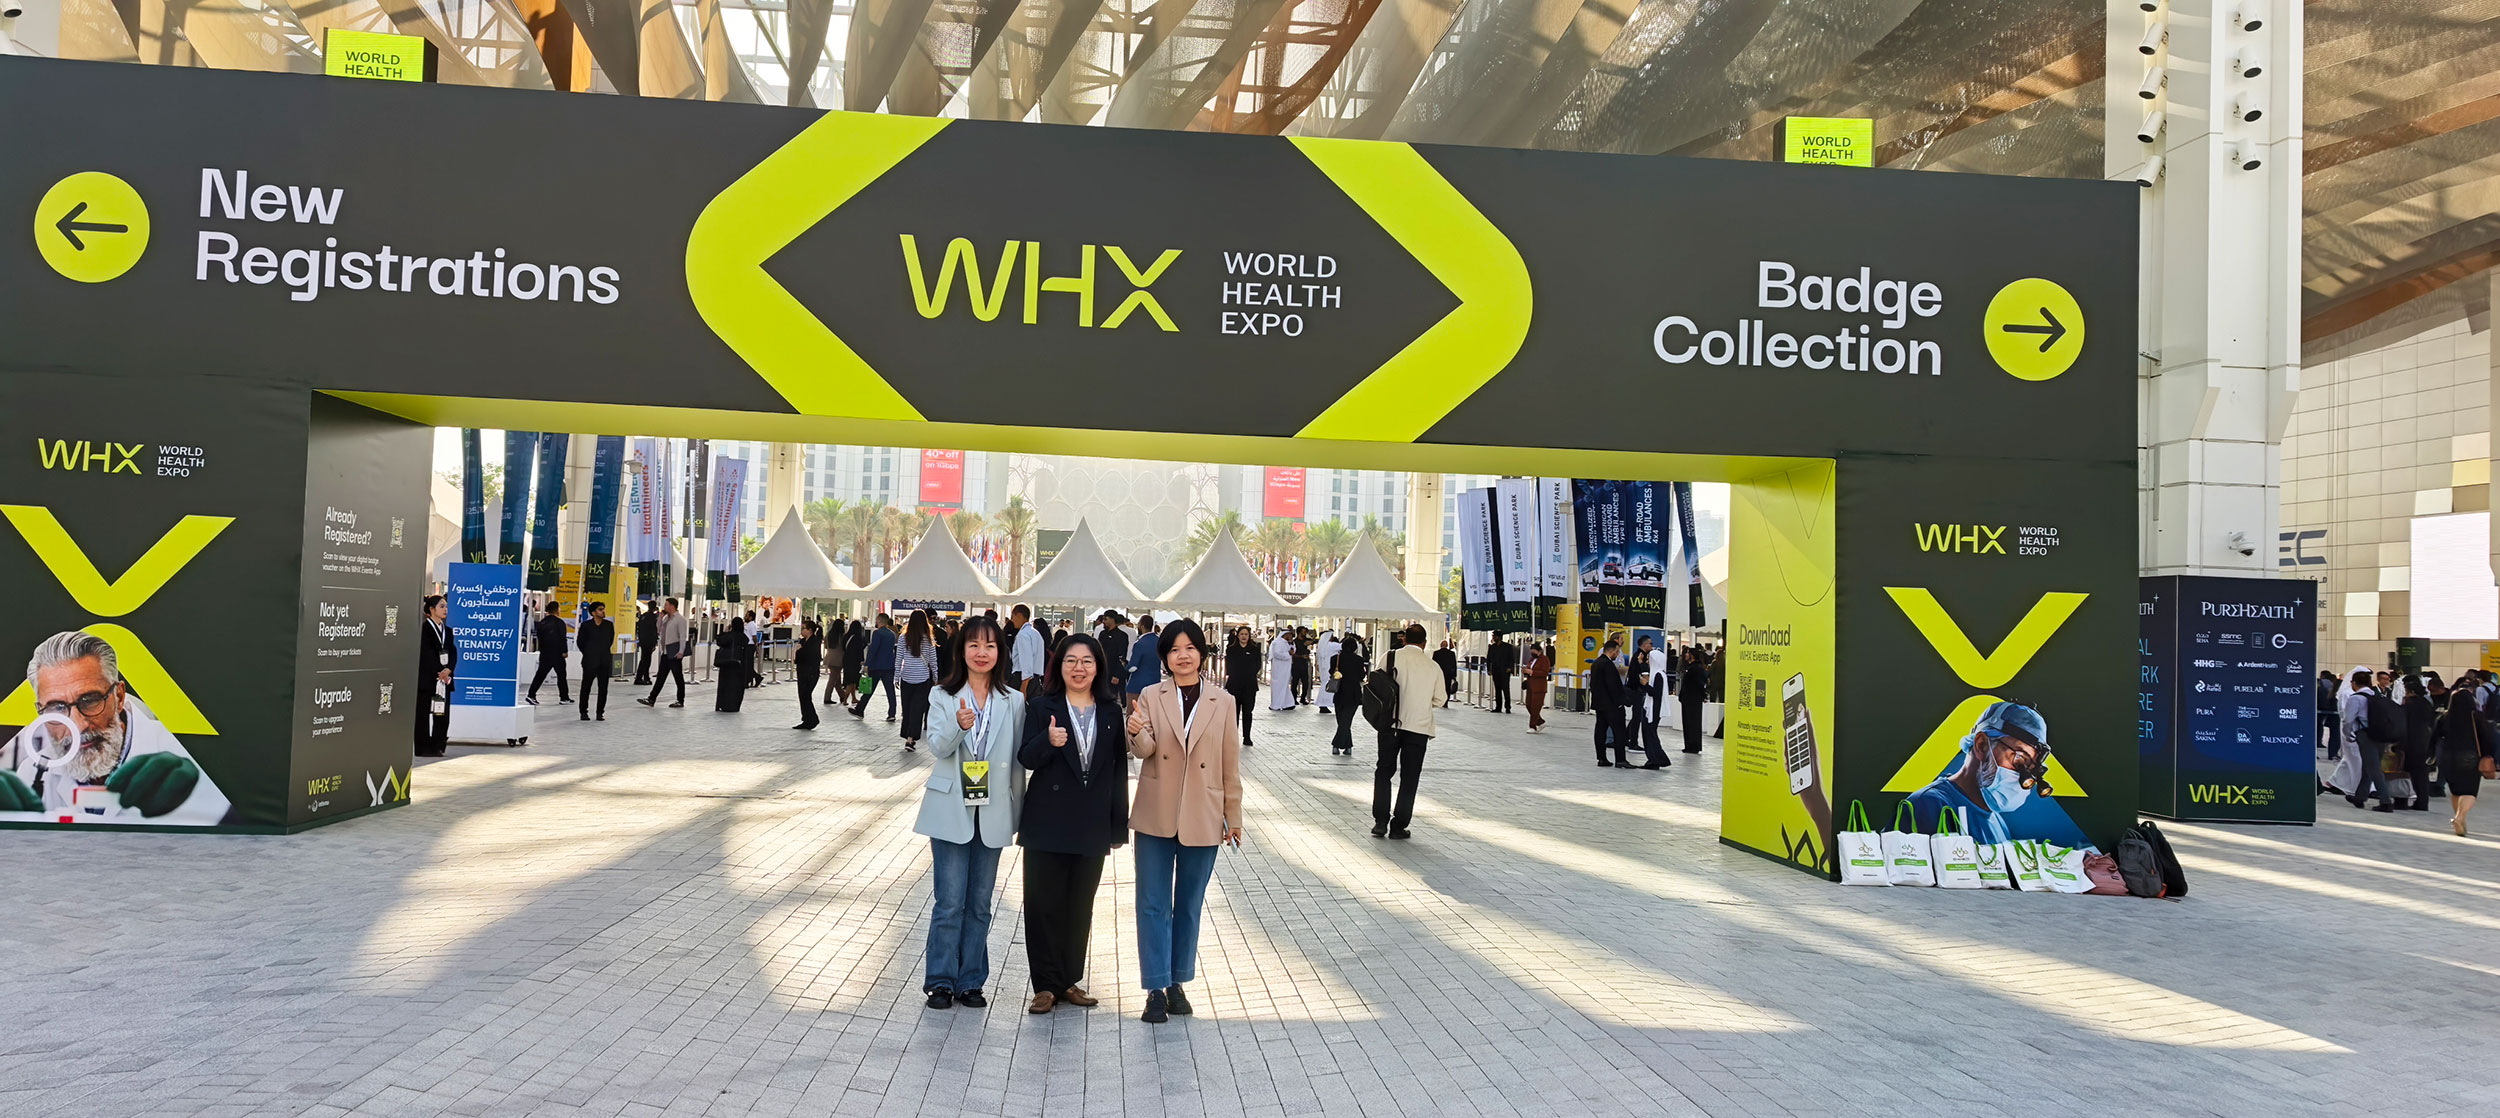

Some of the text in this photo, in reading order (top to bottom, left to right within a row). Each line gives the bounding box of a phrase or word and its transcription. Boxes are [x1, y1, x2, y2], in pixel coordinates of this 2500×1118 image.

[345, 50, 400, 65] WORLD
[344, 64, 402, 79] HEALTH
[1802, 136, 1851, 147] WORLD
[1802, 148, 1853, 160] HEALTH
[199, 168, 344, 226] New
[195, 230, 621, 305] Registrations
[1223, 251, 1337, 278] WORLD
[899, 233, 1184, 333] WHX
[1222, 281, 1341, 309] HEALTH
[1758, 261, 1943, 330] Badge
[1221, 311, 1304, 337] EXPO
[1653, 316, 1942, 376] Collection
[38, 438, 145, 475] WHX
[159, 445, 204, 456] WORLD
[158, 456, 205, 467] HEALTH
[157, 467, 190, 478] EXPO
[641, 464, 652, 536] Healthineers
[326, 506, 357, 528] Already
[1612, 492, 1620, 545] AMBULANCES
[1636, 502, 1644, 543] OFF-ROAD
[1644, 488, 1652, 544] AMBULANCES
[324, 525, 372, 546] Registered?
[1914, 523, 2007, 554] WHX
[2019, 526, 2058, 536] WORLD
[2019, 536, 2060, 546] HEALTH
[2019, 546, 2048, 556] EXPO
[484, 585, 518, 596] موظفي
[320, 602, 349, 622] Not yet
[1630, 596, 1661, 610] WHX
[2201, 601, 2294, 619] PUREHEALTH
[468, 612, 502, 622] الضيوف
[318, 622, 366, 641] Registered?
[452, 627, 513, 638] EXPO STAFF/
[1740, 624, 1791, 646] Download
[458, 640, 507, 650] TENANTS/
[463, 652, 500, 662] GUESTS
[1740, 651, 1781, 665] WHX Events App
[314, 686, 352, 708] Upgrade
[2274, 686, 2300, 694] PURECS
[2196, 708, 2214, 716] PURA
[308, 777, 330, 796] WHX
[2189, 784, 2249, 805] WHX
